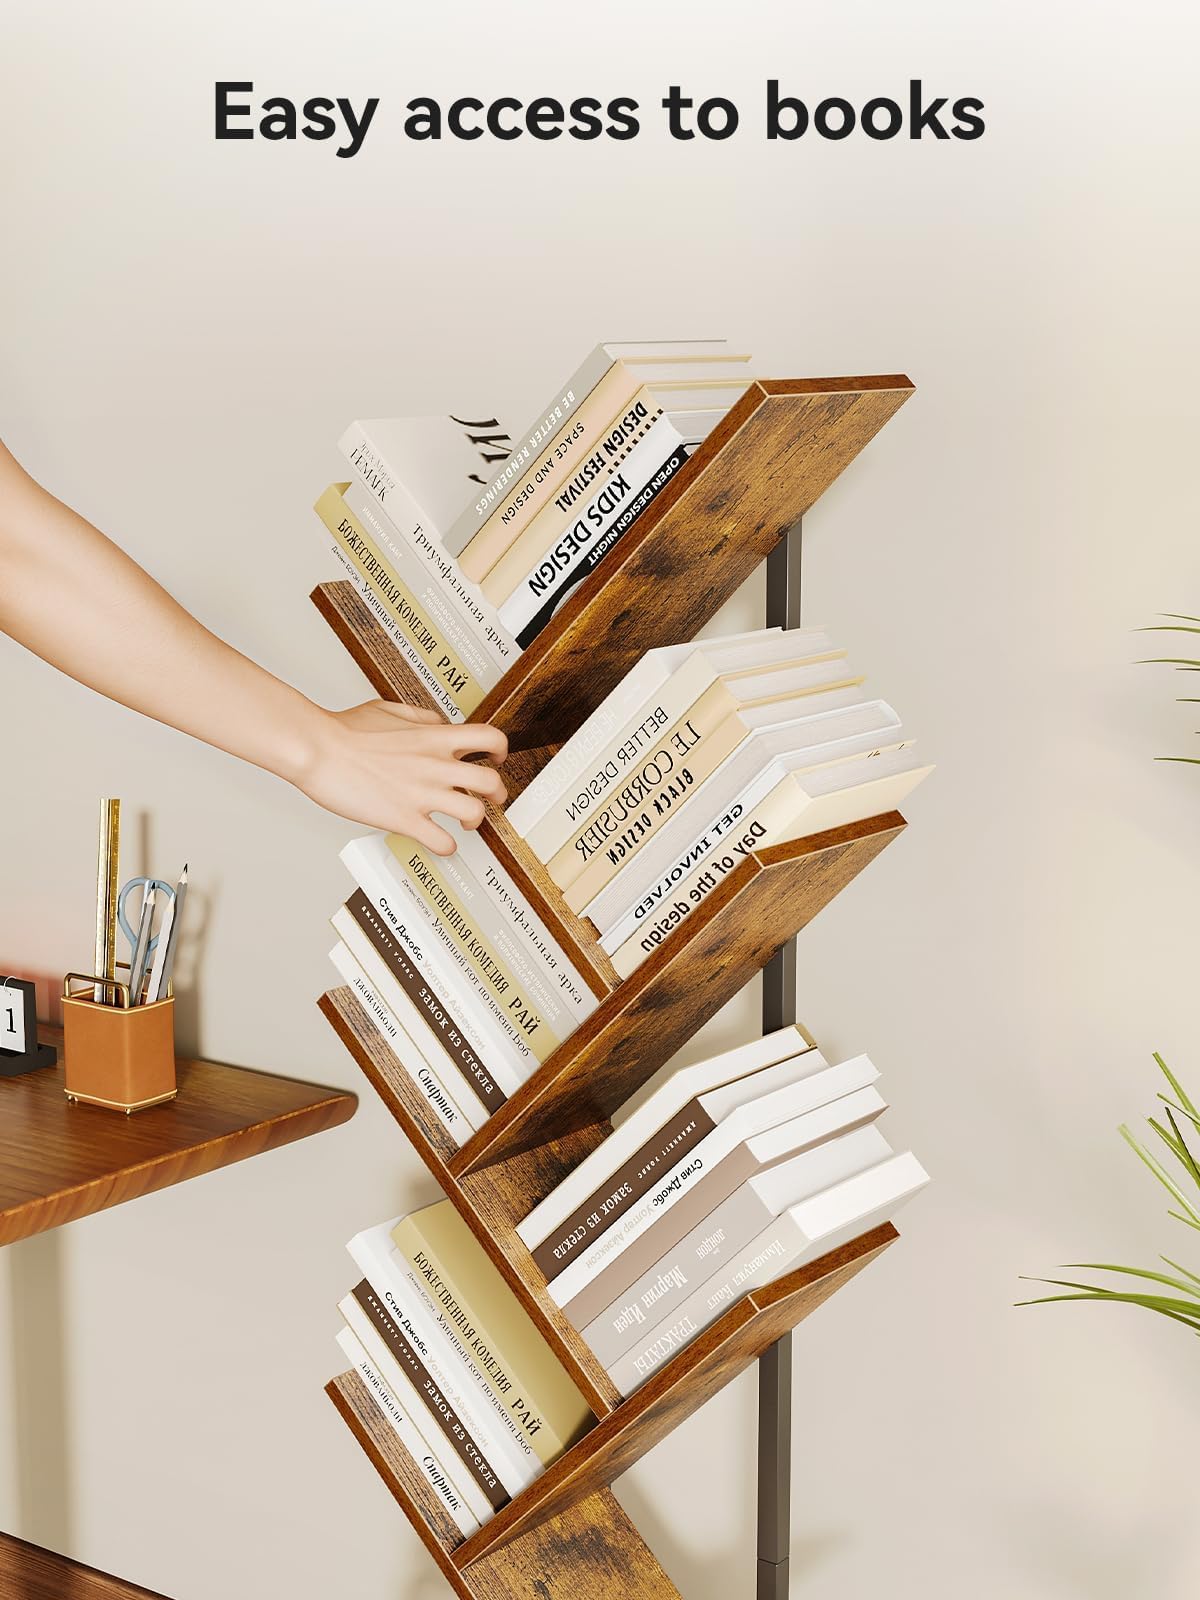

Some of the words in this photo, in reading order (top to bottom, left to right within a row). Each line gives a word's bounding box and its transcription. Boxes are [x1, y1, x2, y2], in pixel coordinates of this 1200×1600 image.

[561, 389, 576, 408] BE
[528, 407, 562, 447] BETTER
[554, 422, 585, 459] SPACE
[602, 401, 648, 456] DESIGN
[474, 447, 530, 515] RENDERINGS
[534, 457, 555, 483] AND
[554, 451, 607, 512] FESTIVAL
[651, 456, 680, 490] OPEN
[500, 482, 535, 524] DESIGN
[586, 473, 632, 527] KIDS
[616, 487, 653, 530] DESIGN
[527, 519, 592, 597] DESIGN
[587, 528, 618, 565] NIGHT
[336, 518, 401, 604] БОЖЕСТВЕННАЯ
[394, 599, 438, 654] КОМЕДИЯ
[435, 654, 469, 693] РАЙ
[410, 523, 485, 623] Триумфальная
[483, 626, 509, 657] арка
[392, 630, 409, 649] кот
[406, 649, 418, 663] по
[416, 662, 442, 696] имени
[440, 693, 460, 716] Боб
[378, 897, 398, 924] Стив
[394, 924, 423, 961] Джобс
[407, 854, 472, 941] БОЖЕСТВЕННАЯ
[466, 938, 510, 994] КОМЕДИЯ
[507, 995, 541, 1035] РАЙ
[483, 865, 558, 969] Триумфальная
[556, 972, 582, 1005] арка
[6, 1008, 16, 1033] 1
[464, 966, 479, 985] кот
[477, 986, 490, 1000] по
[487, 1000, 514, 1035] имени
[418, 987, 449, 1029] замок
[447, 1029, 461, 1047] из
[460, 1048, 493, 1094] стекла
[416, 1067, 458, 1123] Спартак
[651, 1175, 682, 1207] Джобс
[679, 1158, 703, 1180] Стив
[585, 1211, 601, 1228] из
[599, 1181, 633, 1215] замок
[552, 1225, 587, 1259] стекла
[639, 1264, 688, 1309] Мартин
[384, 1291, 403, 1318] Стив
[400, 1319, 428, 1356] Джобс
[412, 1251, 476, 1339] БОЖЕСТВЕННАЯ
[469, 1337, 512, 1394] КОМЕДИЯ
[510, 1396, 543, 1436] РАЙ
[611, 1302, 646, 1335] Иден
[631, 1315, 700, 1374] ТРАКТАТЫ
[467, 1362, 483, 1381] кот
[480, 1382, 493, 1397] по
[490, 1396, 516, 1432] имени
[422, 1379, 453, 1421] замок
[451, 1423, 465, 1440] из
[464, 1442, 497, 1488] стекла
[421, 1455, 462, 1511] Спартак
